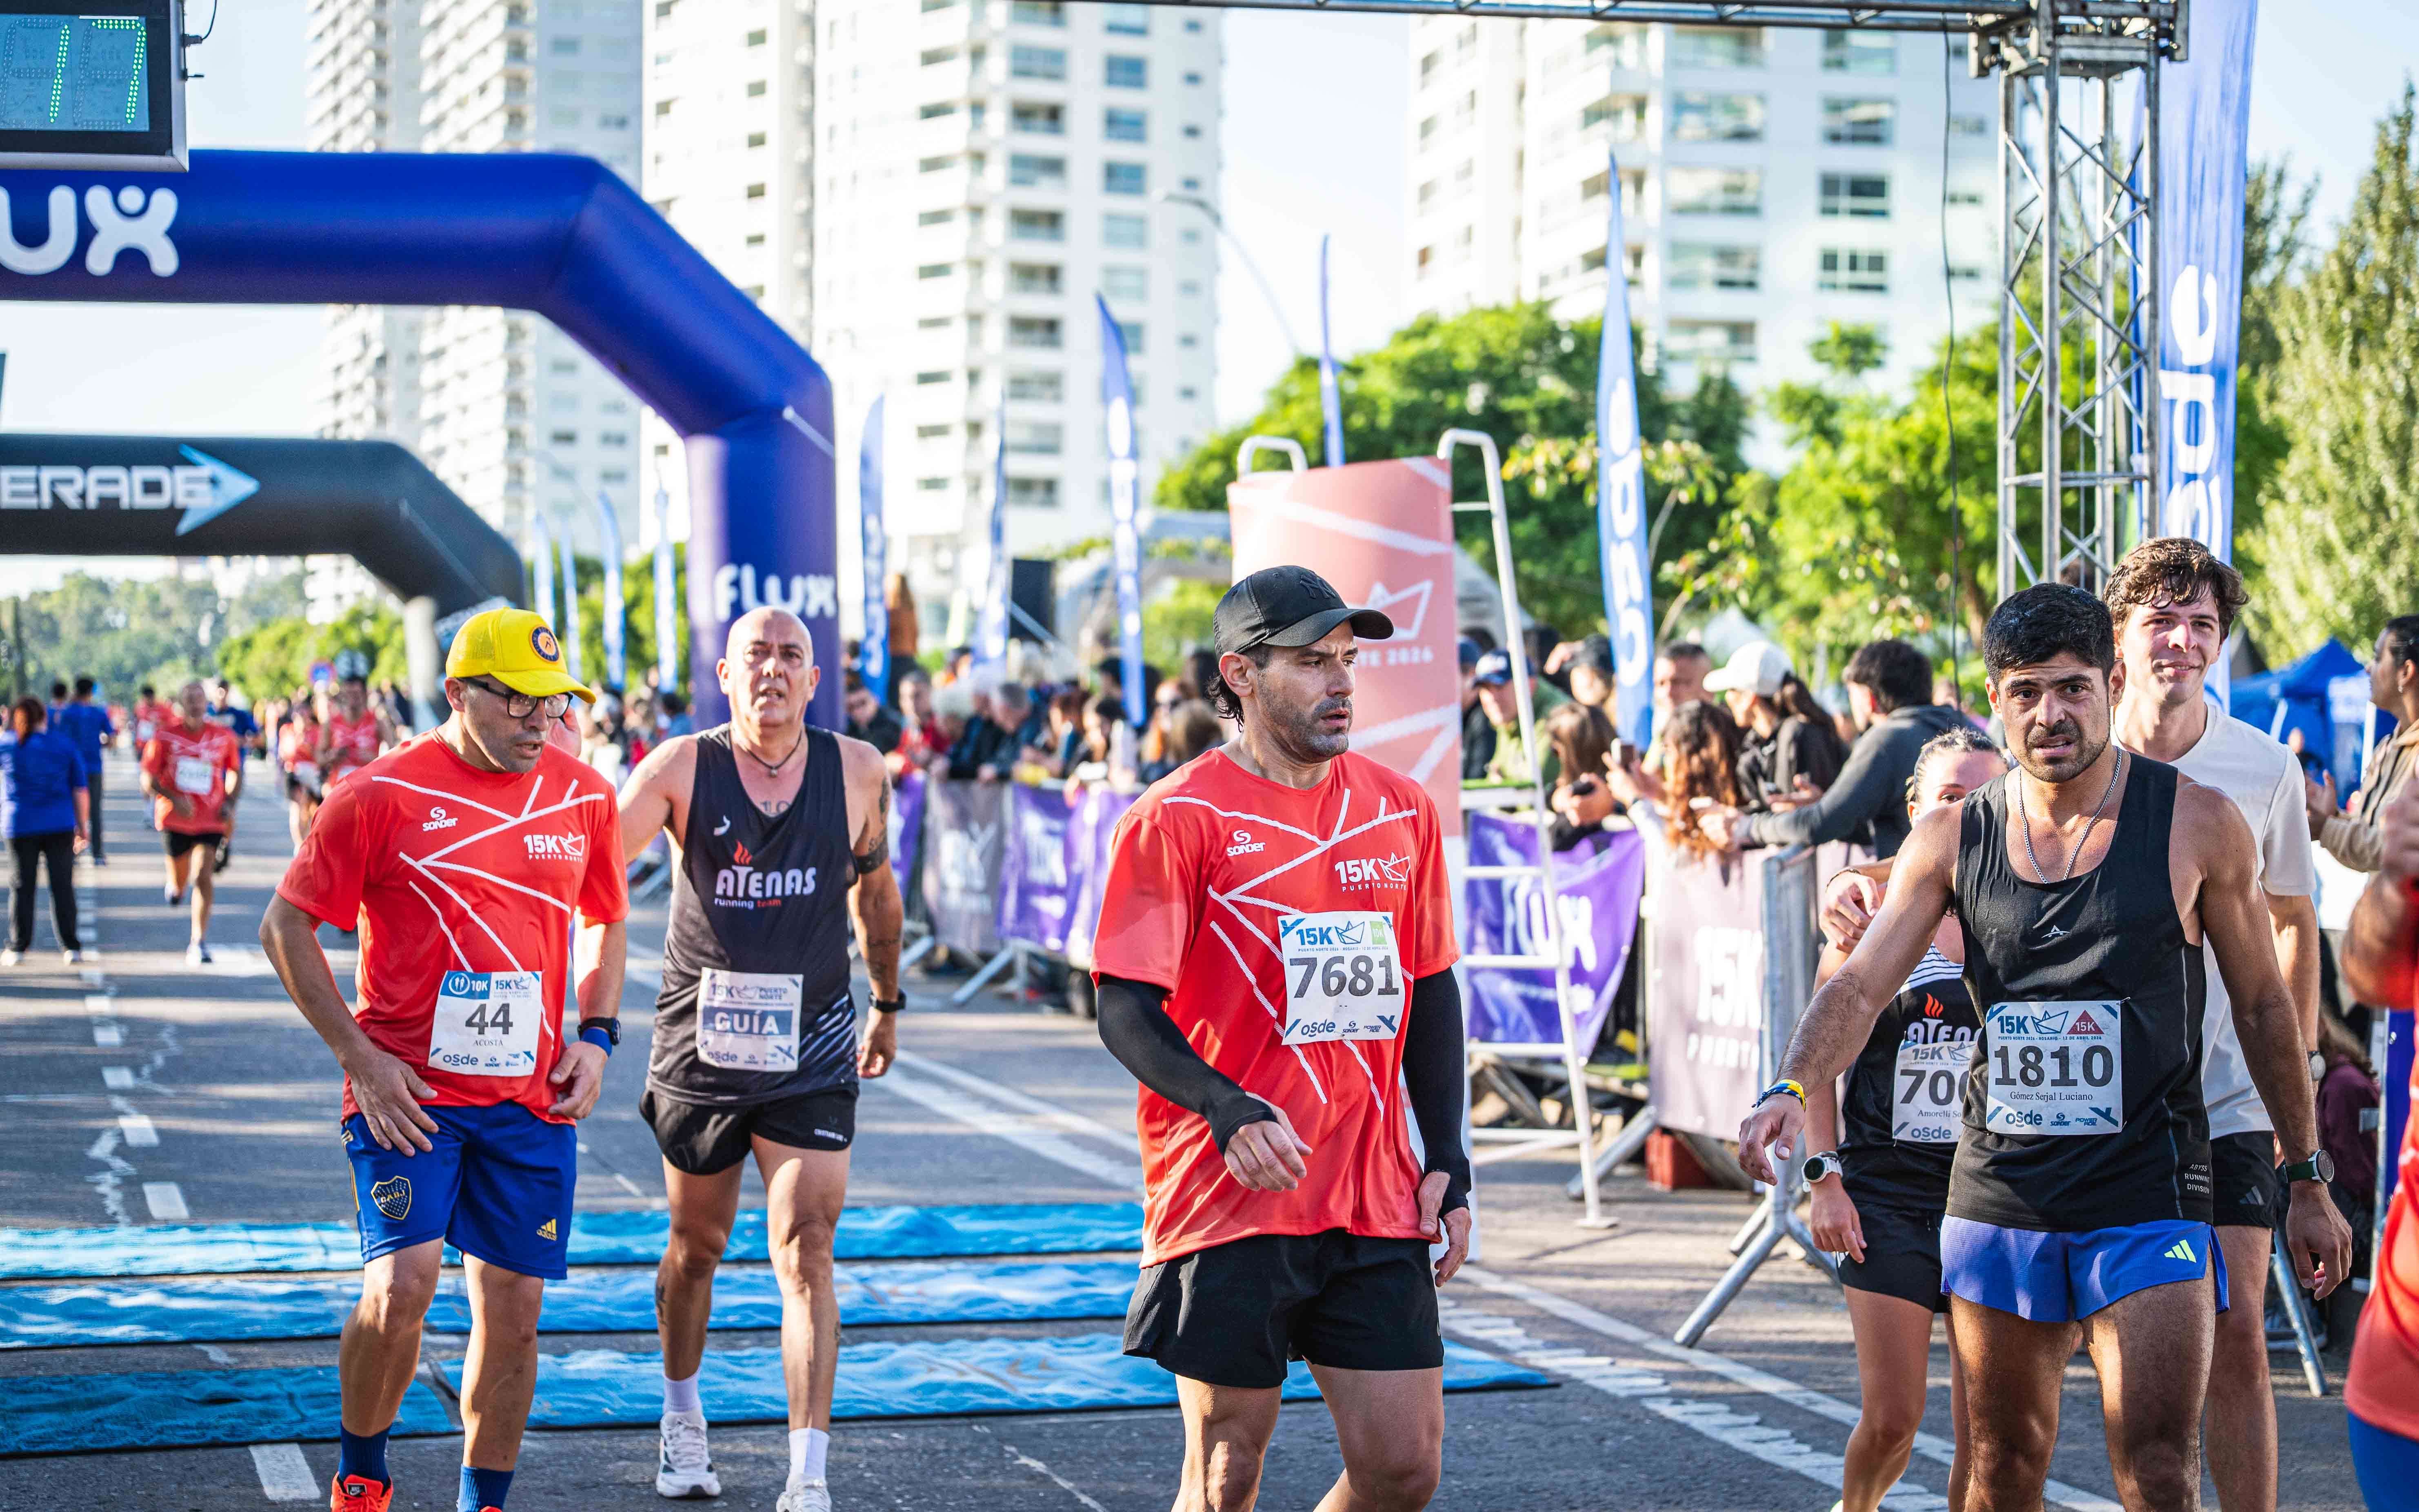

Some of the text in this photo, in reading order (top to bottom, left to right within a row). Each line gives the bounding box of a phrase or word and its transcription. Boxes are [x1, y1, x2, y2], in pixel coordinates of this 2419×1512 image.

[50, 19, 147, 124] 17
[0, 465, 212, 509] ERADE
[524, 835, 560, 854] 15K
[1335, 858, 1378, 884] 15K
[715, 865, 816, 898] ATENAS
[715, 898, 781, 910] running team
[1296, 927, 1333, 946] 15K
[471, 980, 488, 991] 10K
[495, 979, 511, 990] 15K
[1290, 955, 1399, 998] 7681
[1695, 926, 1763, 1029] 15K
[465, 1004, 513, 1035] 44
[715, 1010, 779, 1034] GUÍA
[1301, 1019, 1336, 1037] osde
[1997, 1016, 2029, 1034] 15K
[2076, 1021, 2095, 1032] 15K
[443, 1054, 478, 1066] osde
[707, 1051, 738, 1063] osde
[1912, 1046, 1944, 1060] 15K
[1994, 1045, 2114, 1087] 1810
[2010, 1092, 2034, 1100] Gómez
[2059, 1092, 2093, 1101] Luciano
[1918, 1110, 1950, 1118] Amorelli
[2006, 1110, 2043, 1128] osde
[1911, 1126, 1952, 1141] osde
[2187, 1183, 2210, 1195] DIVISION
